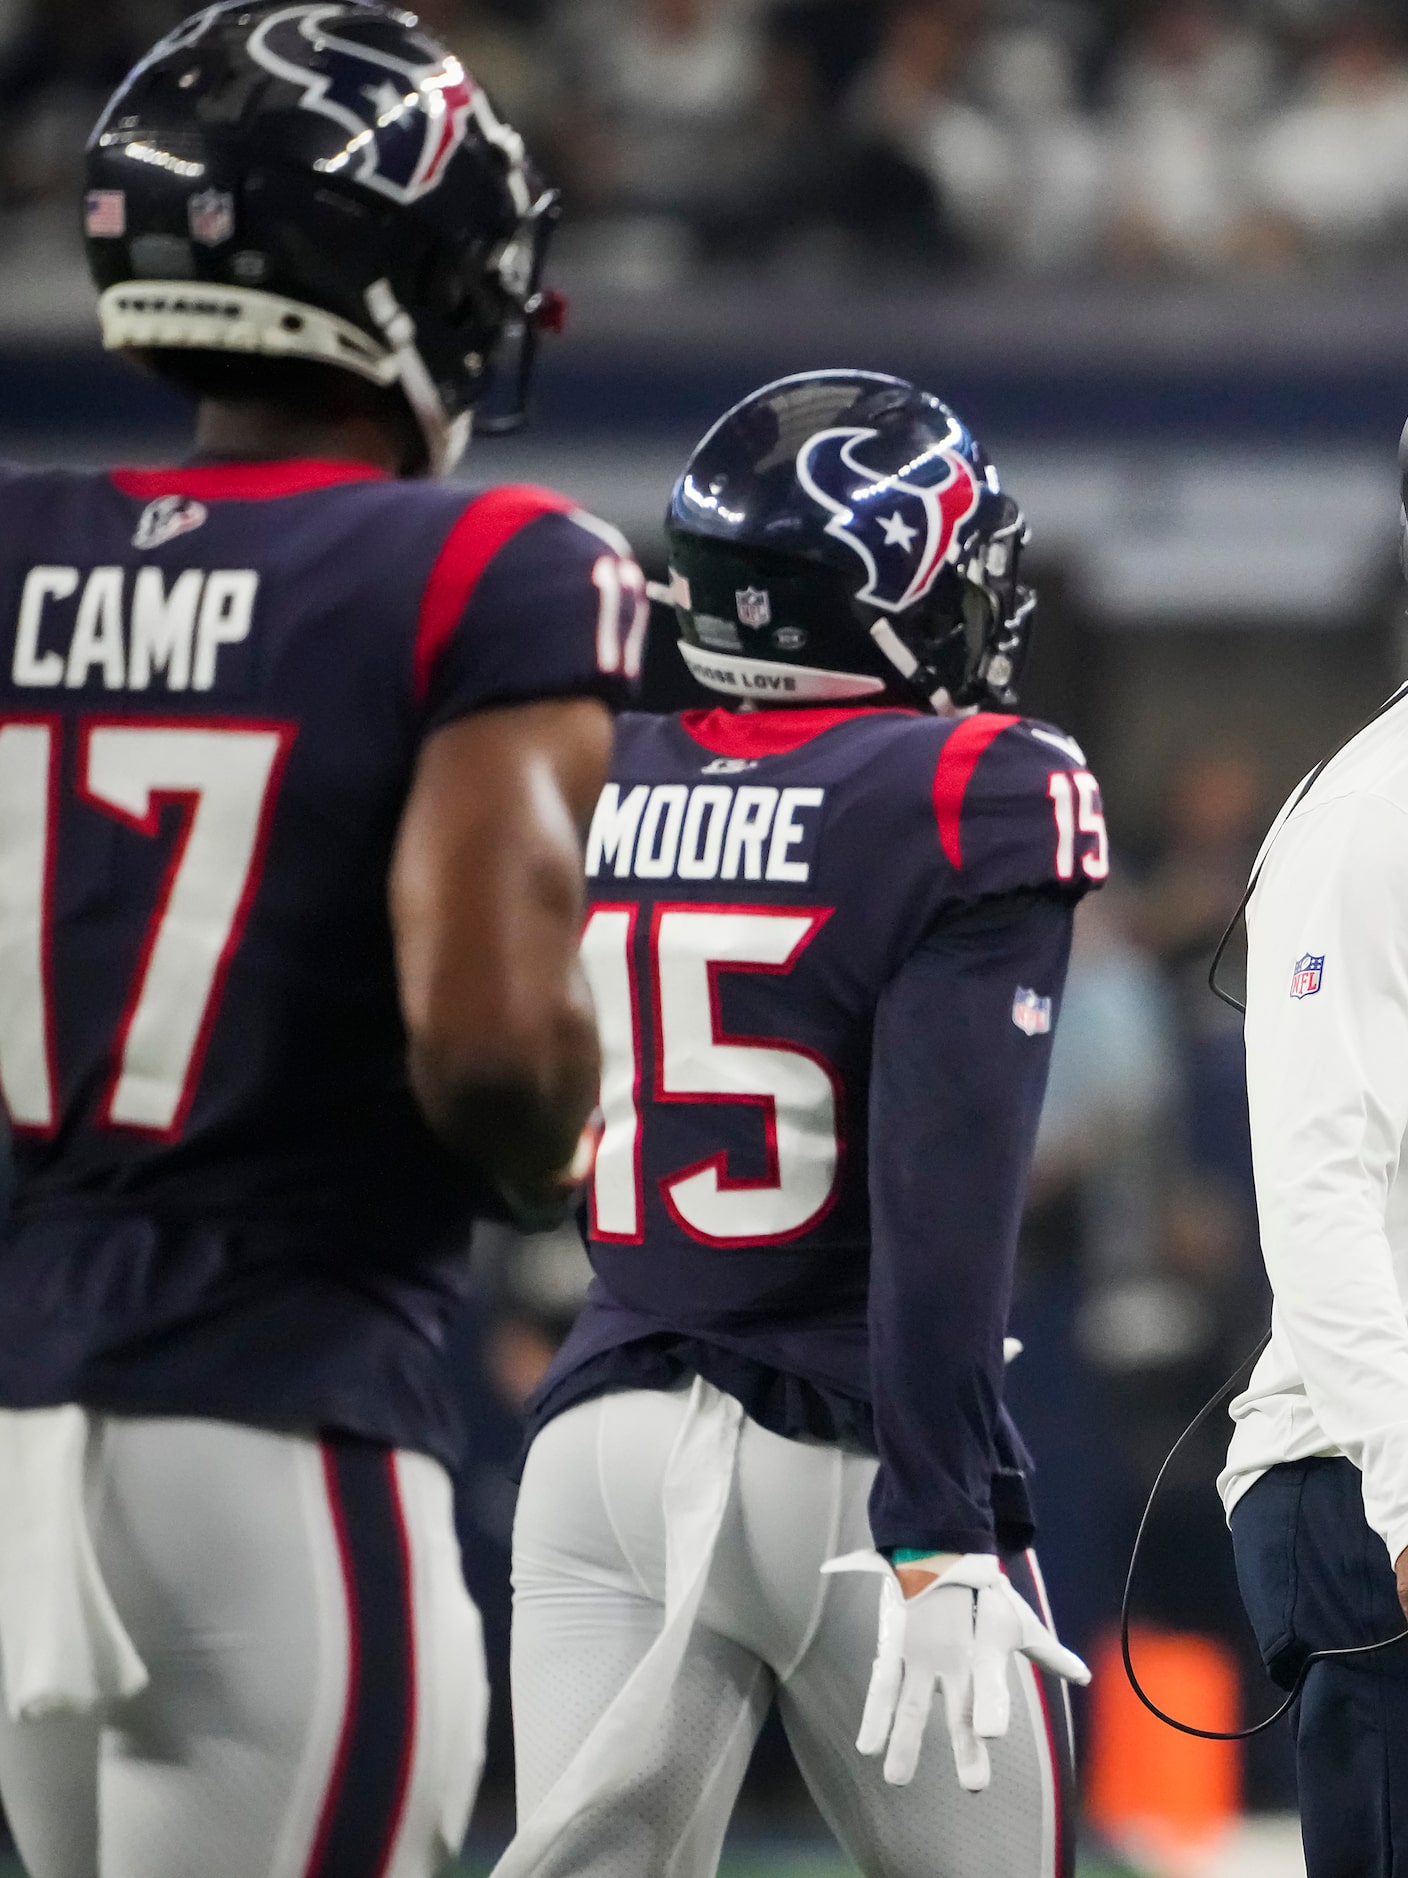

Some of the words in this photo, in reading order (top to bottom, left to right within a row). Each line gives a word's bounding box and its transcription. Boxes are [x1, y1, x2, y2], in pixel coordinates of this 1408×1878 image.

[11, 564, 260, 692] CAMP
[742, 674, 796, 691] LOVE
[584, 783, 825, 883] MOORE
[1046, 769, 1110, 881] 15
[0, 714, 299, 1146] 17
[1292, 971, 1318, 995] NFL
[578, 901, 847, 1249] 15
